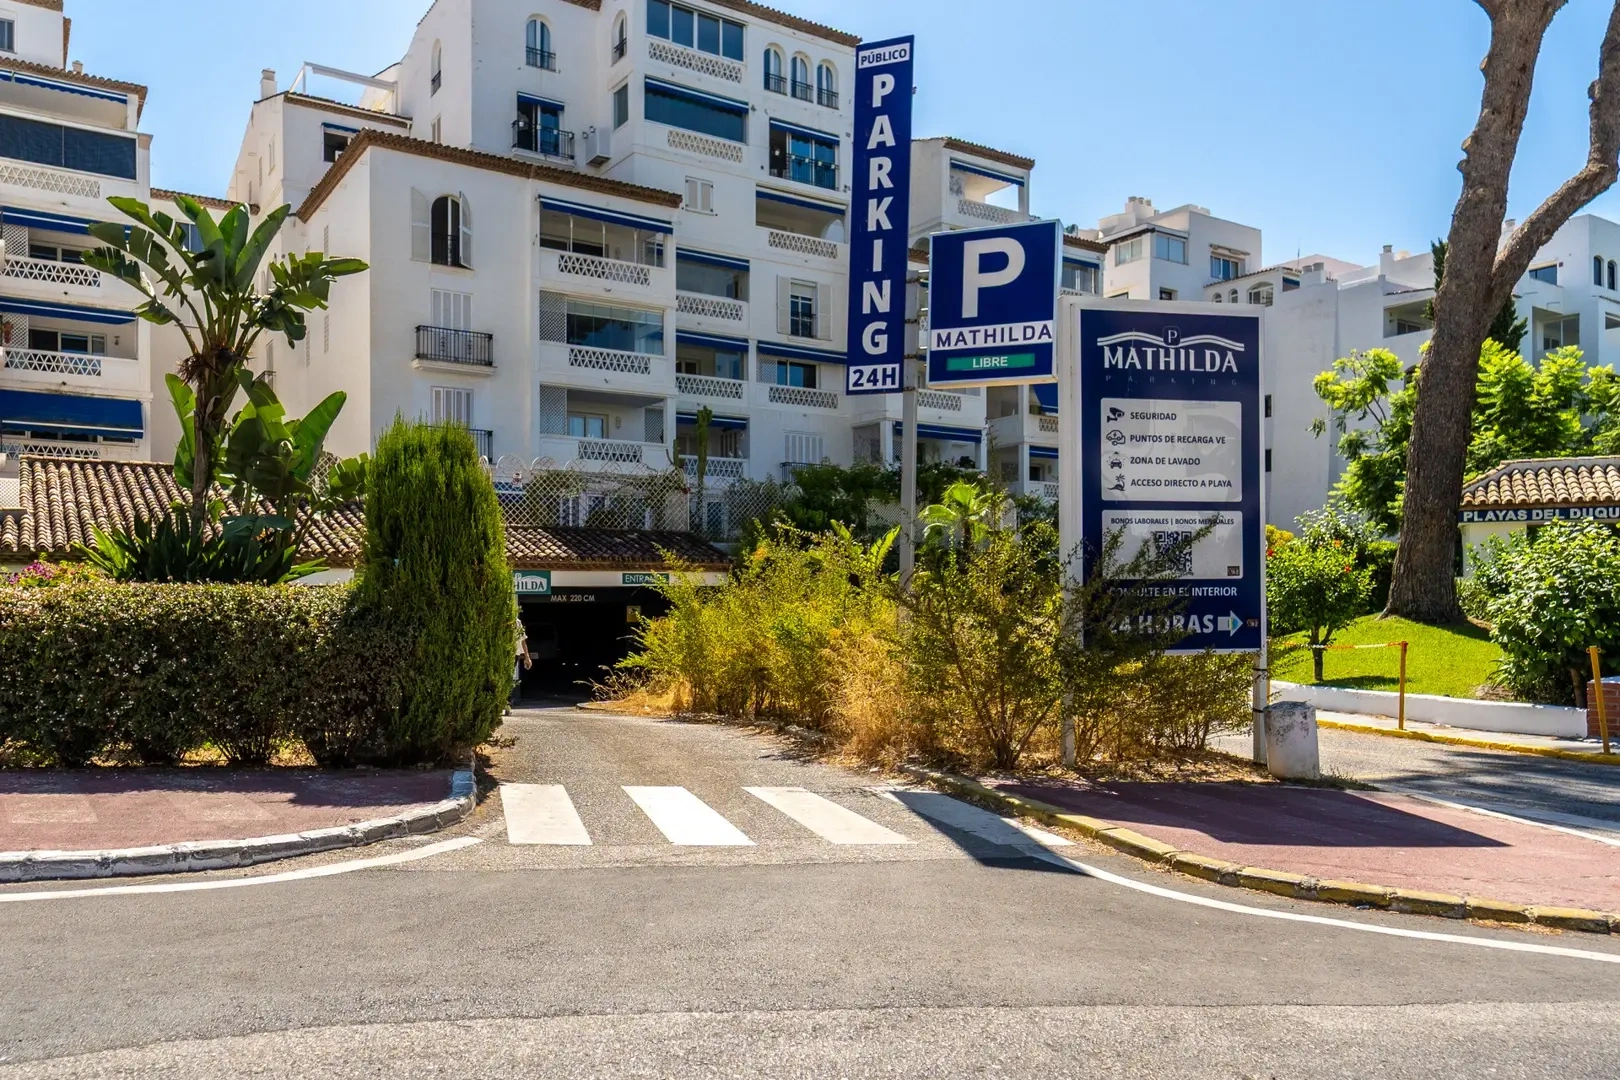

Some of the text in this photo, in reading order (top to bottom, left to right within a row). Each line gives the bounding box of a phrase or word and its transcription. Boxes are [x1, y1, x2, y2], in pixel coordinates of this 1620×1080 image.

[860, 48, 908, 66] PÚBLICO
[862, 73, 896, 355] PARKING
[961, 237, 1027, 319] P
[936, 322, 1053, 348] MATHILDA
[1167, 330, 1178, 343] P
[972, 356, 1009, 369] LIBRE
[1103, 346, 1239, 373] MATHILDA
[851, 366, 897, 388] 24H
[1105, 375, 1237, 386] PARKING
[1130, 411, 1177, 421] SEGURIDAD
[1130, 434, 1226, 445] PUNTOS DE RECARGA VE
[1130, 456, 1201, 466] ZONA DE LAVADO
[1131, 478, 1233, 488] ACCESO DIRECTO A PLAYA
[1110, 517, 1133, 525] BONOS
[1463, 510, 1527, 522] PLAYAS
[1532, 508, 1565, 520] DEL
[514, 580, 545, 590] HILDA
[1163, 587, 1176, 596] EN
[1191, 586, 1238, 596] INTERIOR
